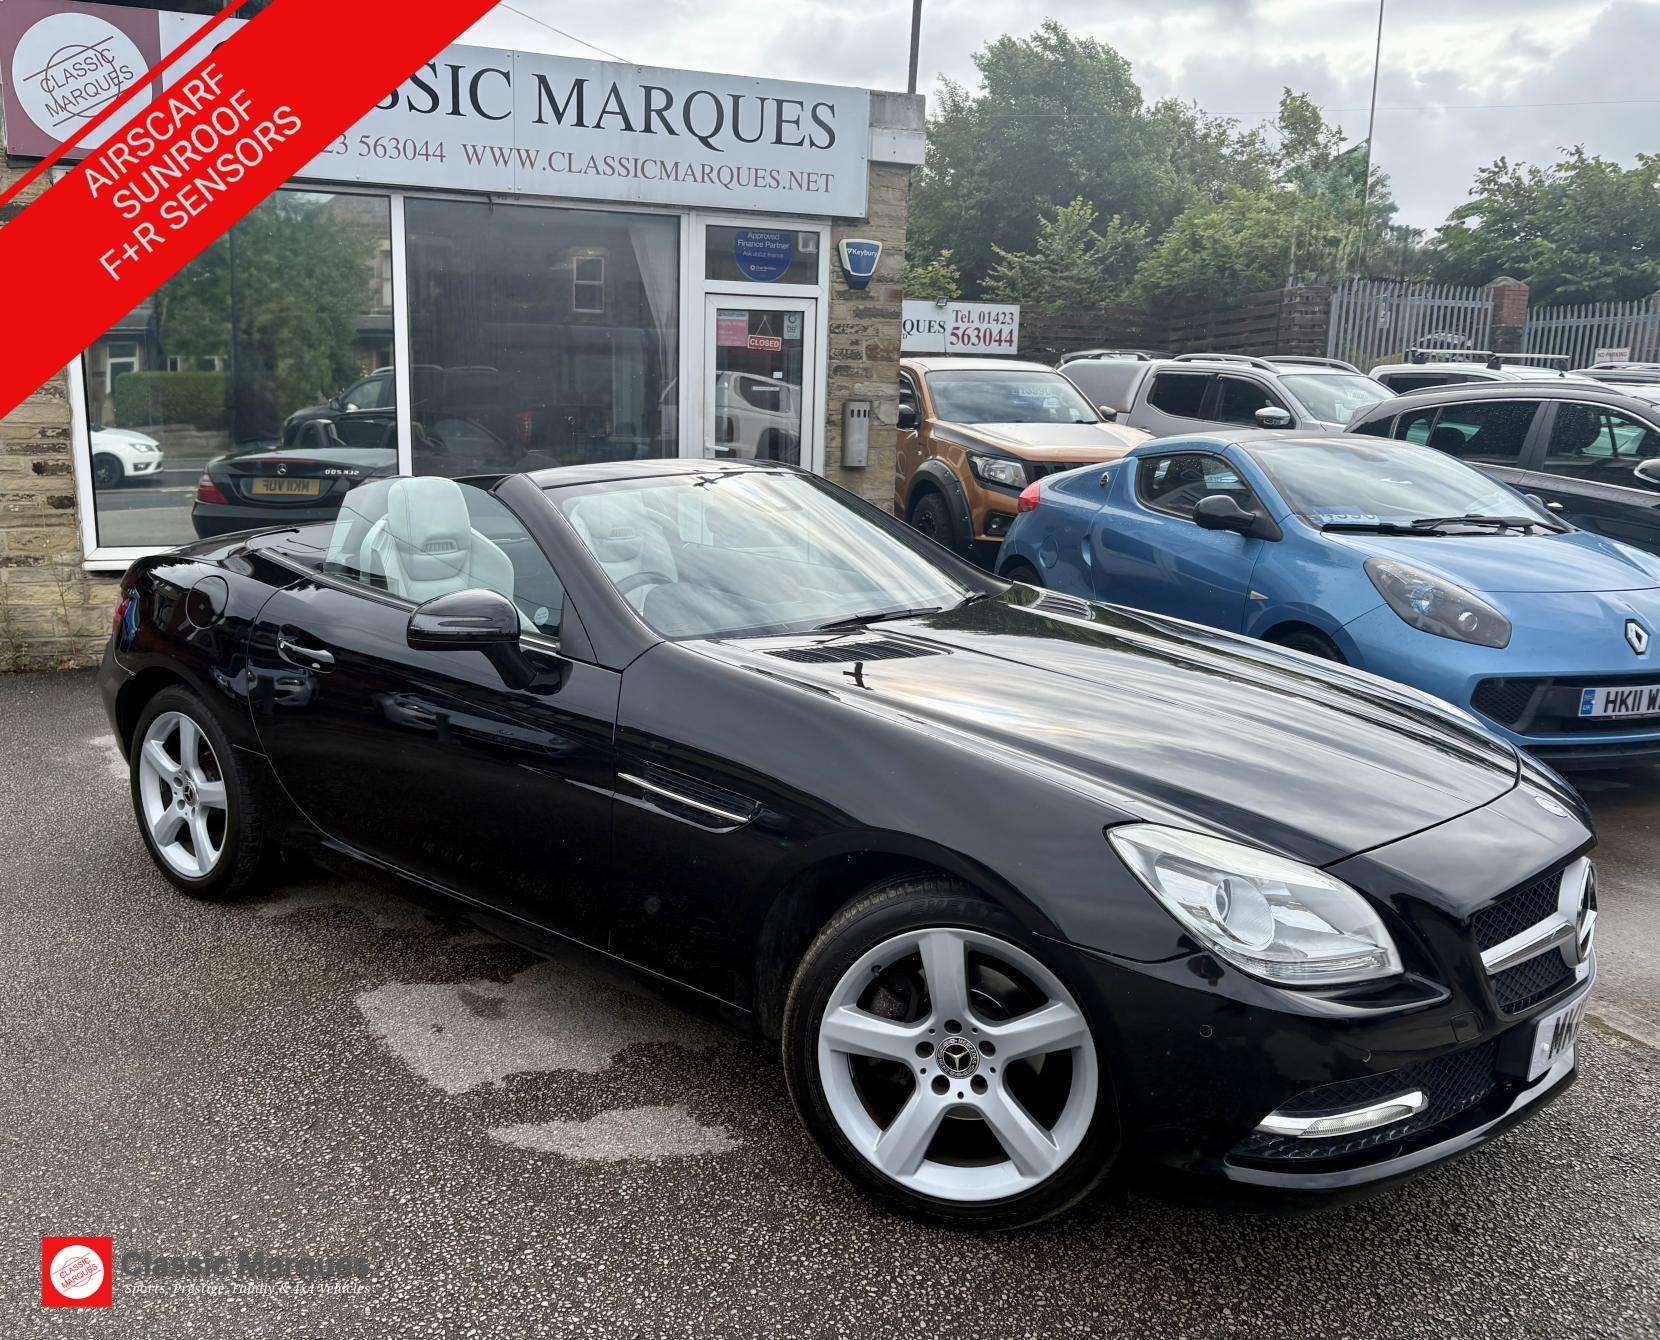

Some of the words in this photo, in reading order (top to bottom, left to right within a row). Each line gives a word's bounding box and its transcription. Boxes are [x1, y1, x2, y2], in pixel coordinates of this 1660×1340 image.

[40, 48, 115, 93] CLASSIC
[45, 65, 134, 118] MARQUES
[531, 73, 837, 152] MARQUES
[358, 135, 446, 163] 563044
[461, 143, 835, 193] WWW.CLASSICMARQUES.NET
[737, 240, 764, 248] Finance
[765, 241, 790, 249] Partner
[747, 231, 780, 241] Approved
[852, 248, 878, 257] Keybury
[952, 310, 974, 324] Tel.
[978, 310, 1015, 325] 01423
[902, 319, 946, 335] QUES
[749, 338, 780, 348] CLOSED
[949, 326, 1014, 347] 563044
[1603, 689, 1644, 713] HK11
[1647, 688, 1660, 711] W
